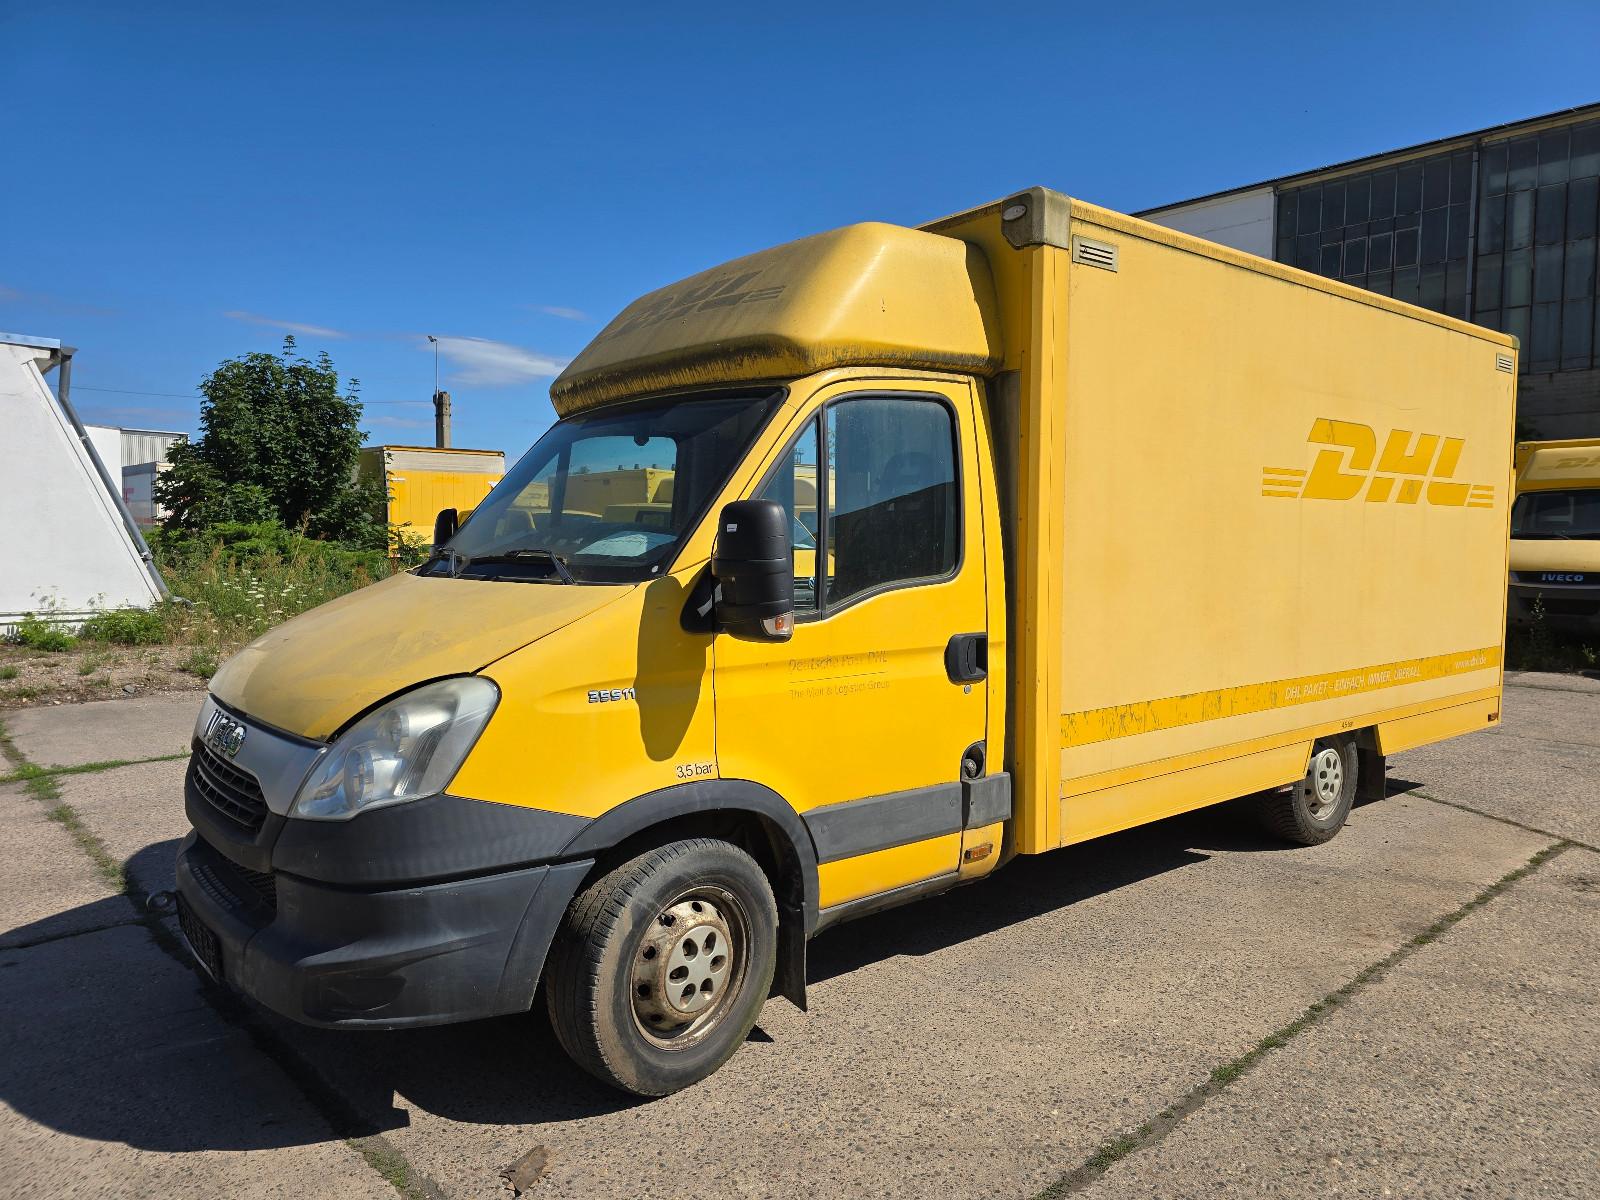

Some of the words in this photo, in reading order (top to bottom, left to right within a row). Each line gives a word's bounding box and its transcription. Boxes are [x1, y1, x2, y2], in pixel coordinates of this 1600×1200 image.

[1301, 418, 1472, 506] DHL
[1541, 573, 1584, 582] IVECO
[587, 687, 636, 704] 35S11
[1285, 686, 1301, 700] DHL
[1303, 681, 1328, 697] PAKET
[676, 764, 694, 779] 3,5
[695, 763, 713, 776] bar
